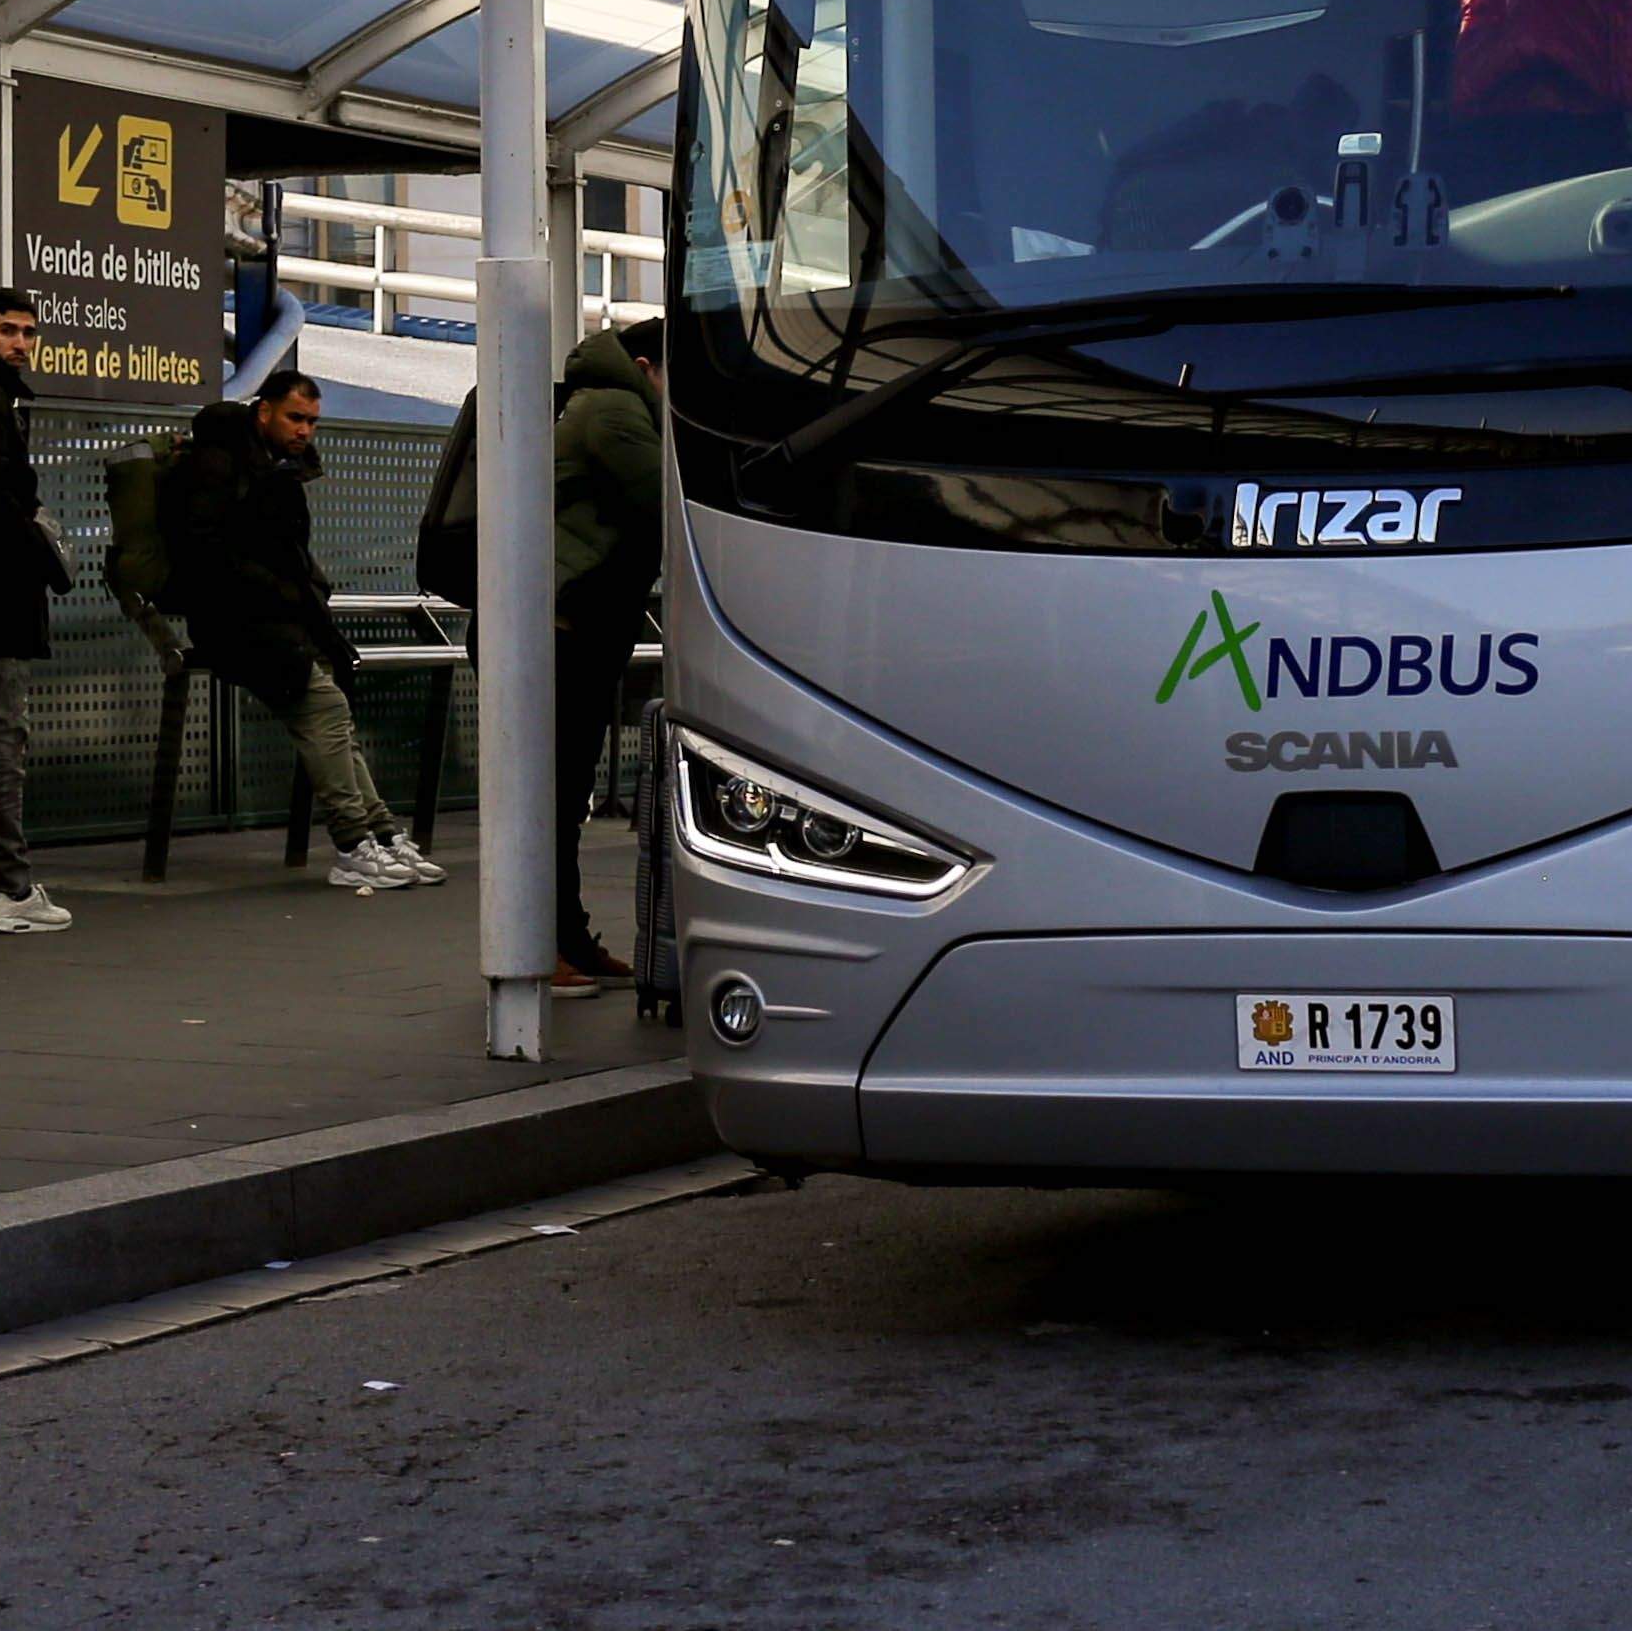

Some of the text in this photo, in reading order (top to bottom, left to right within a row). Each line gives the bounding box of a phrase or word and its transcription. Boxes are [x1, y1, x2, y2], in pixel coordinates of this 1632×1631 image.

[26, 233, 201, 291] Venda de bitllets
[27, 289, 127, 331] Ticket sales
[29, 335, 200, 386] Venta de billetes
[1154, 588, 1540, 713] ANDBUS
[1223, 729, 1459, 772] SCANIA
[1307, 1001, 1443, 1051] R 1739
[1255, 1050, 1294, 1066] AND
[1308, 1055, 1441, 1065] PRINCIPAT D'ANDORRA
